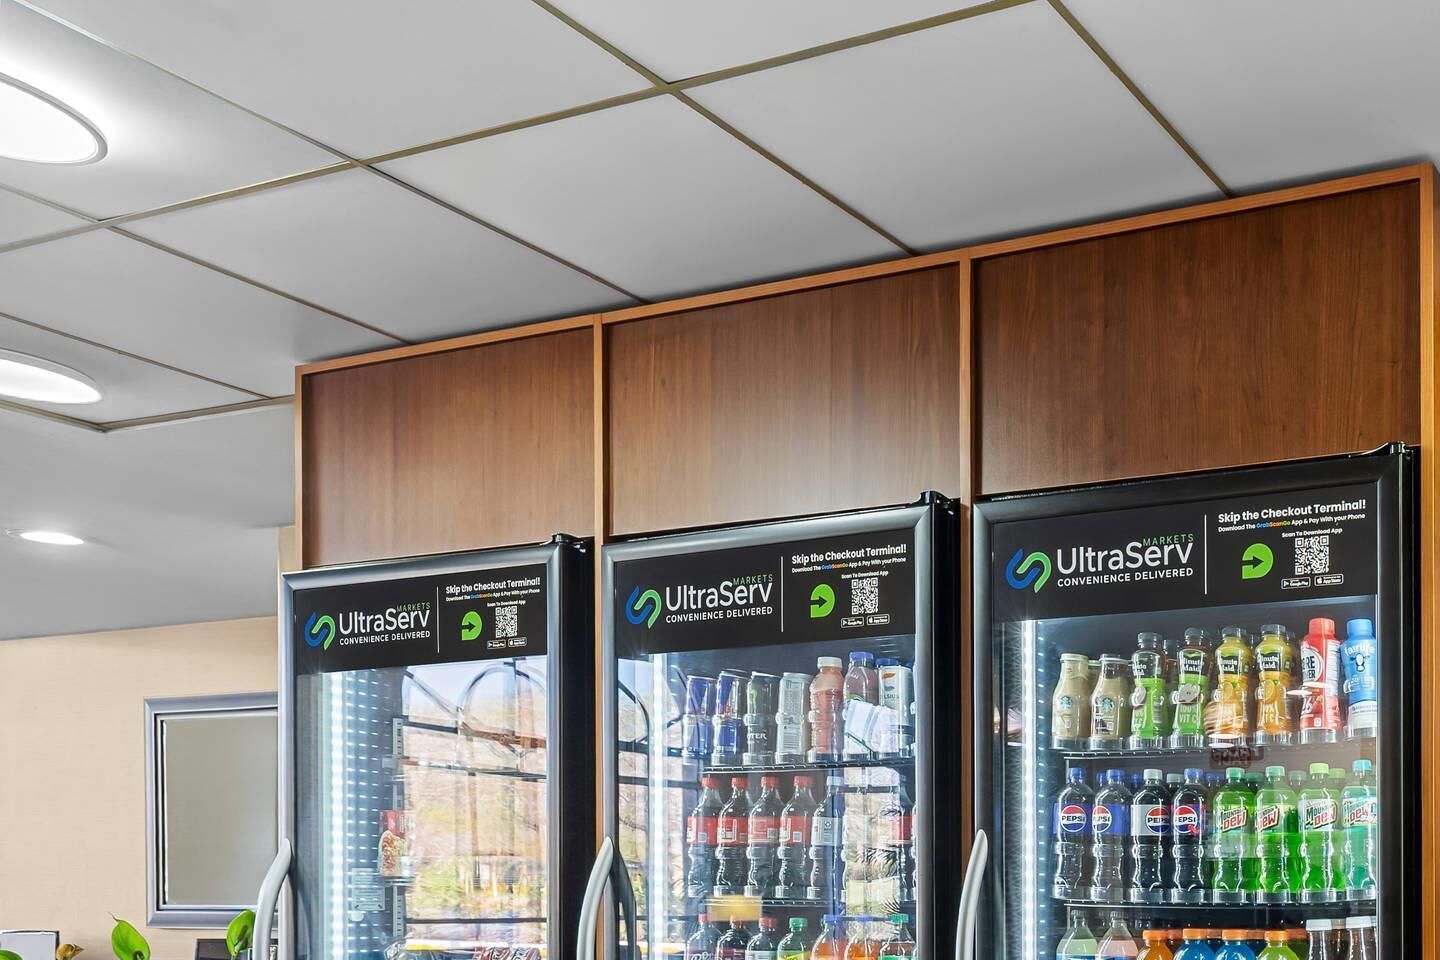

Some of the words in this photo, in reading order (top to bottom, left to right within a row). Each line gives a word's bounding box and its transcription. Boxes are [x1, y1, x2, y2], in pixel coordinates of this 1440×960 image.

[1218, 511, 1241, 524] Skip
[1242, 511, 1259, 521] the
[1261, 506, 1312, 520] Checkout
[1313, 499, 1366, 514] Terminal!
[1218, 523, 1245, 533] Download
[1308, 517, 1319, 525] Pay
[1334, 515, 1347, 524] your
[1281, 531, 1296, 539] Scan
[1303, 528, 1330, 536] Download
[1331, 527, 1343, 535] App
[1143, 533, 1194, 546] MARKETS
[791, 553, 810, 566] Skip
[810, 553, 824, 563] the
[825, 548, 865, 561] Checkout
[865, 544, 907, 557] Terminal!
[1057, 541, 1193, 575] UltraServ
[791, 565, 813, 574] Download
[848, 561, 858, 569] App
[892, 556, 907, 564] Phone
[446, 585, 461, 595] Skip
[461, 584, 473, 592] the
[473, 579, 506, 592] Checkout
[507, 577, 540, 588] Terminal!
[733, 574, 773, 585] MARKETS
[1057, 573, 1131, 587] CONVENIENCE
[1135, 567, 1194, 581] DELIVERED
[665, 581, 773, 612] UltraServ
[397, 602, 431, 612] MARKETS
[666, 610, 724, 624] CONVENIENCE
[726, 606, 773, 618] DELIVERED
[339, 608, 430, 635] UltraServ
[339, 635, 389, 646] CONVENIENCE
[391, 630, 431, 641] DELIVERED
[1345, 643, 1376, 655] fairlife
[1061, 814, 1086, 823] PEPSI
